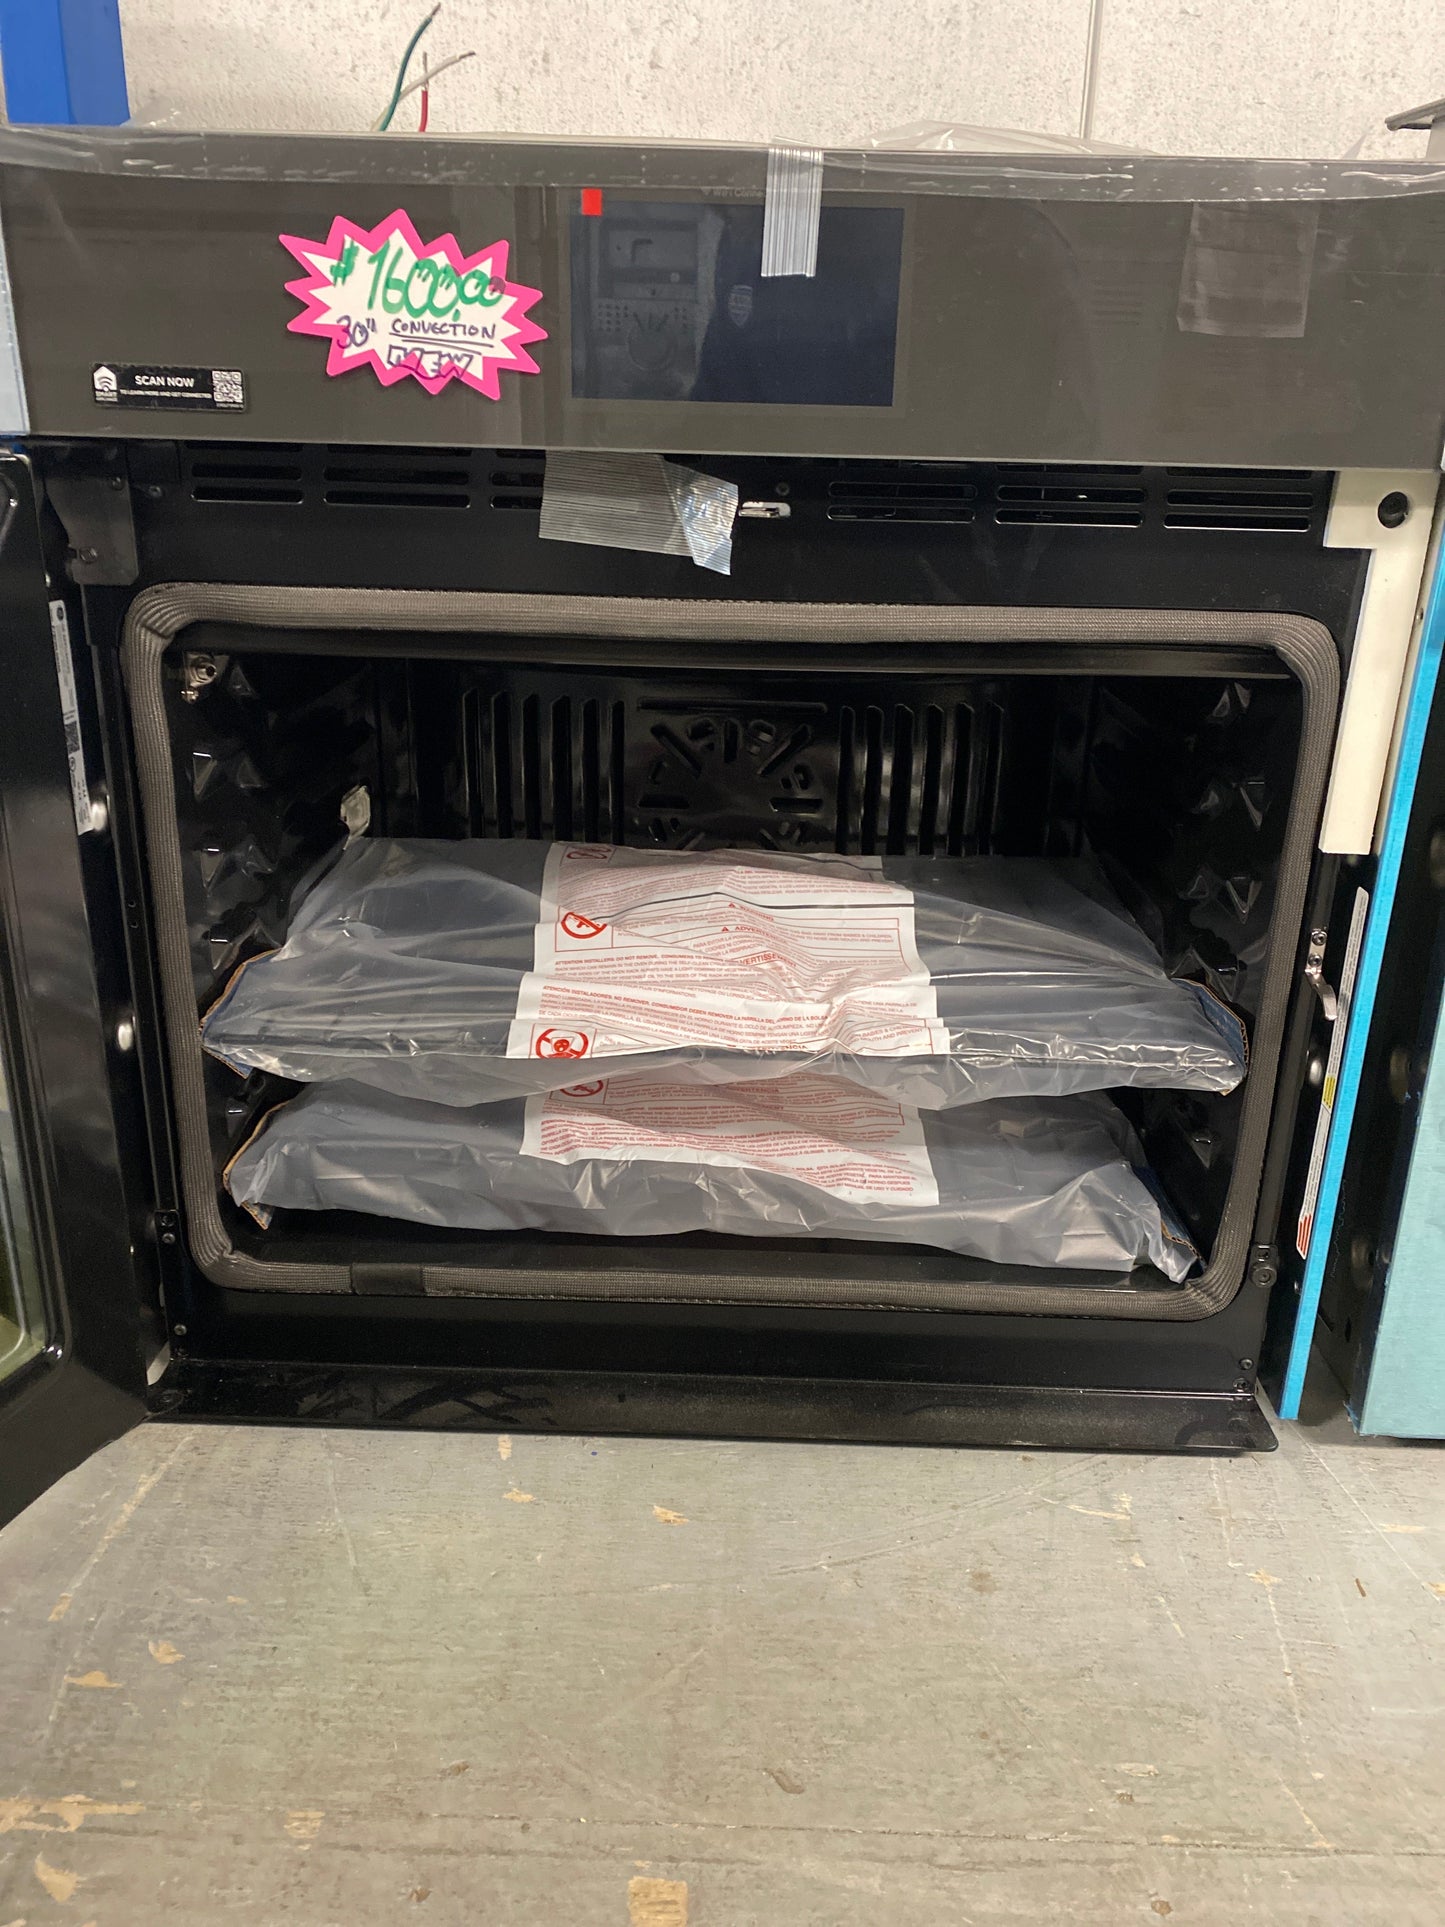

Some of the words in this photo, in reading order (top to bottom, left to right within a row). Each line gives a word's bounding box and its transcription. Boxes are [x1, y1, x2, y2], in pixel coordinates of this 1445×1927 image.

[391, 318, 496, 340] CONVECTION
[134, 375, 166, 387] SCAN
[167, 376, 195, 388] NOW
